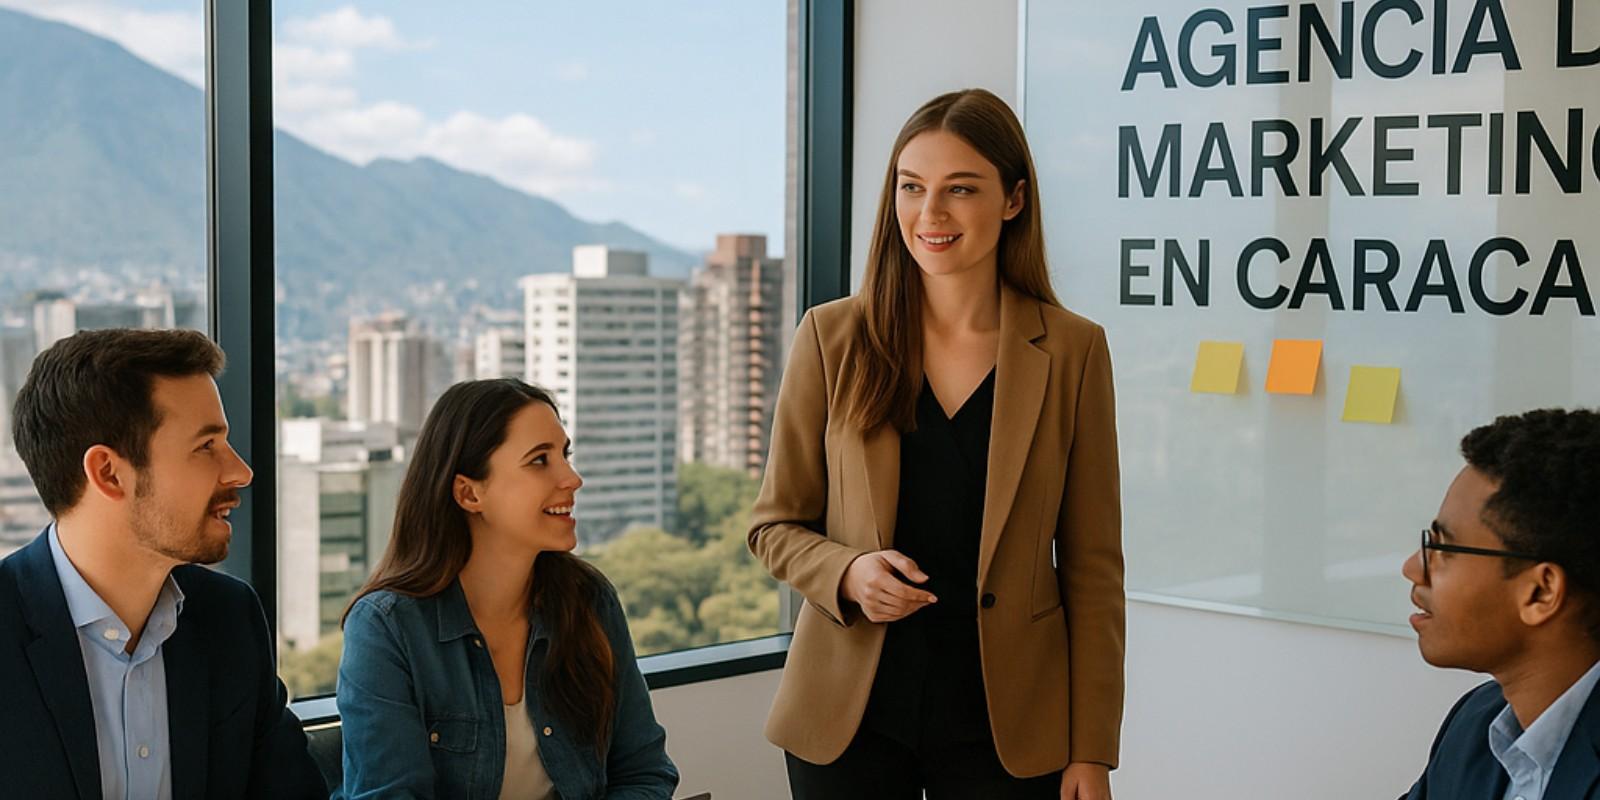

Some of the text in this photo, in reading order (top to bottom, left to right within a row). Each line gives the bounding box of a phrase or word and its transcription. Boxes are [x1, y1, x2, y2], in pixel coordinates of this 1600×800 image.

[1120, 0, 1523, 91] AGENCIA
[1117, 107, 1600, 199] MARKETIN
[1119, 237, 1597, 317] EN CARACA
